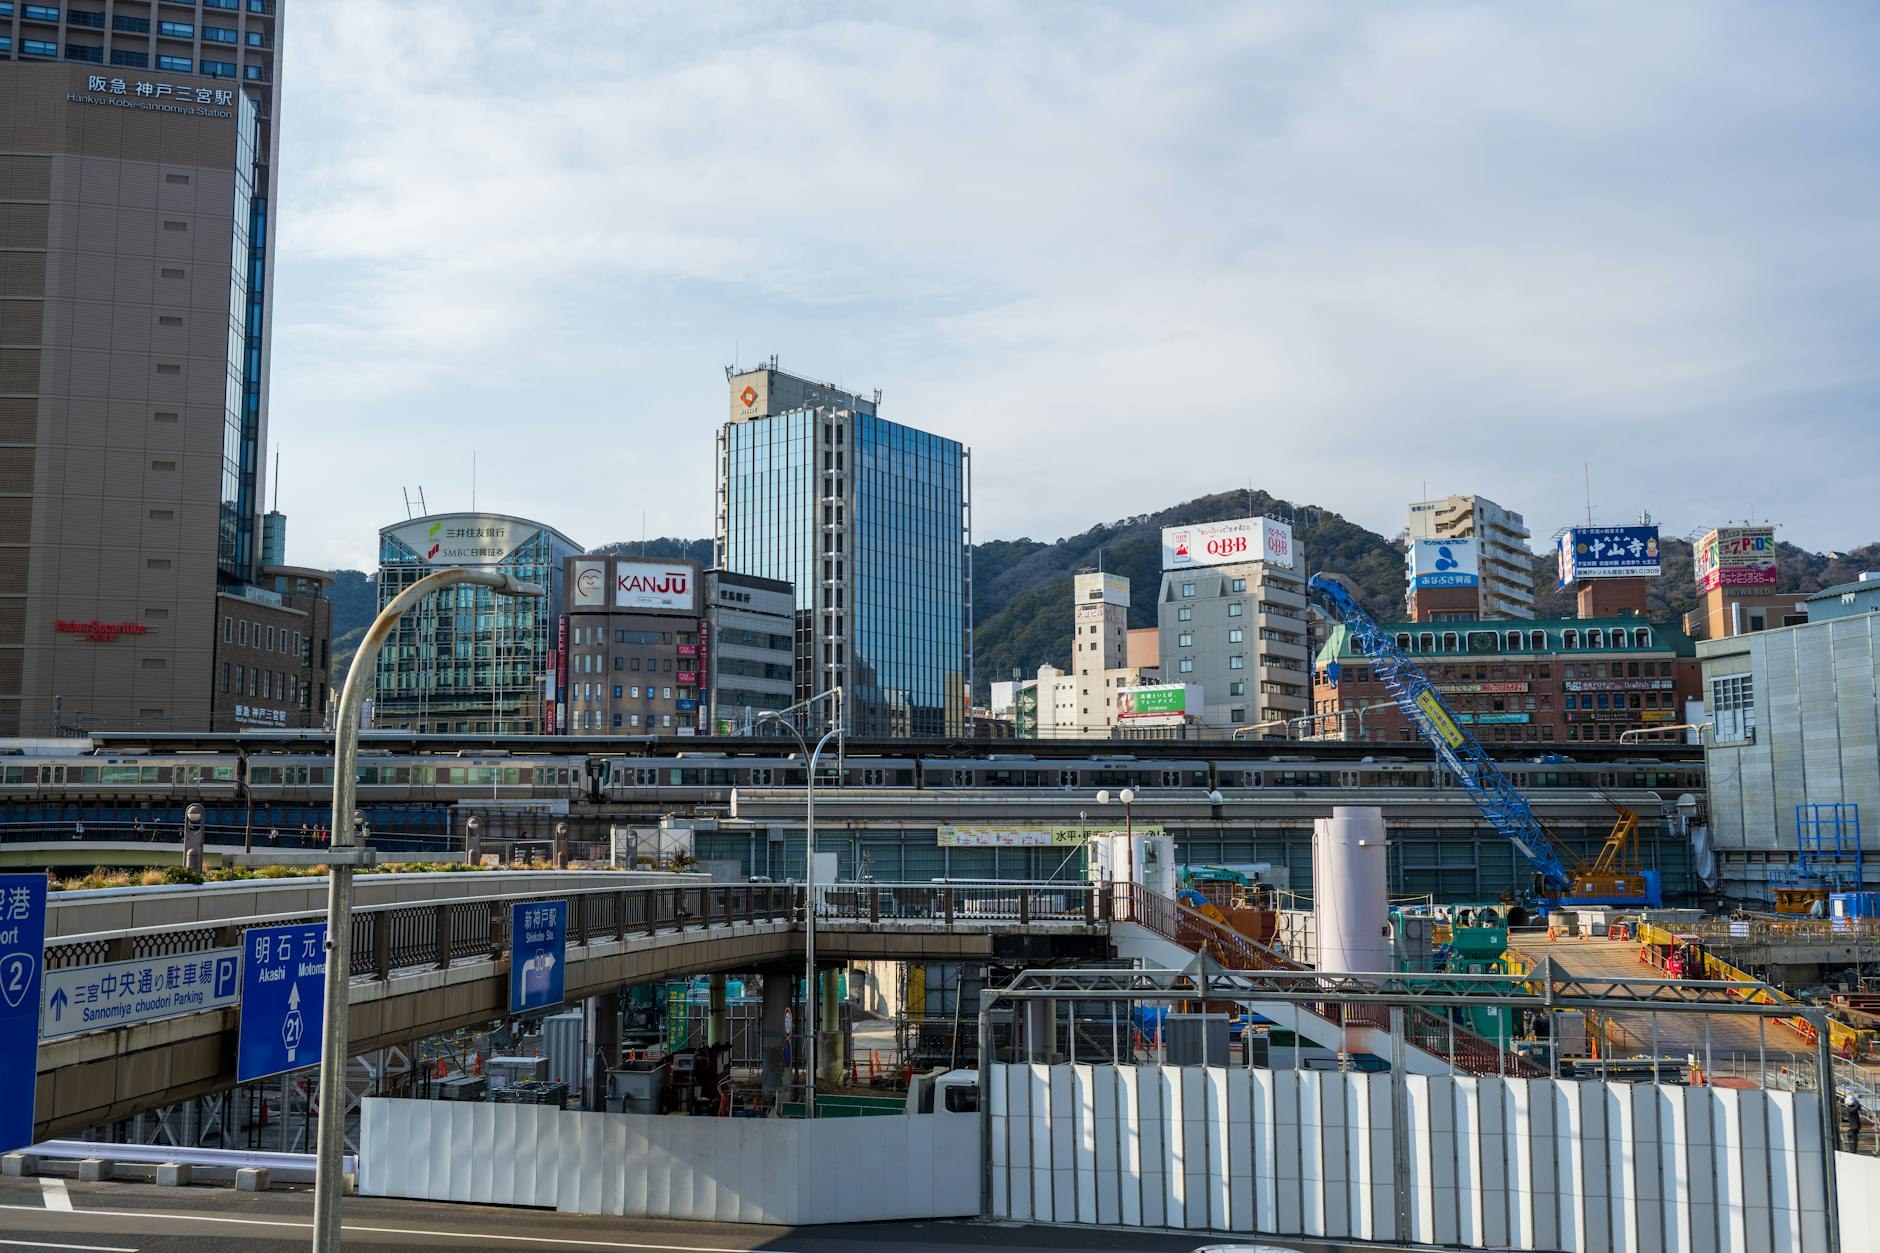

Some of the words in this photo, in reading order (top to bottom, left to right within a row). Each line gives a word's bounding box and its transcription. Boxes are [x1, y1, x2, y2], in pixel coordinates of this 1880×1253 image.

[88, 75, 127, 95] 阪急
[136, 81, 232, 106] 神戸三宮駅
[67, 92, 106, 105] Hankyu
[109, 98, 195, 116] Kobe-sannomiya
[197, 107, 232, 118] Station
[446, 527, 505, 538] 三井住友銀行
[1589, 537, 1644, 559] 中山寺
[235, 704, 250, 717] 阪急
[0, 886, 31, 921] 港
[525, 907, 557, 930] 新神戸駅
[0, 926, 19, 945] ort
[9, 960, 23, 992] 2
[258, 965, 286, 983] Akashi
[298, 961, 327, 977] Motoma
[83, 1001, 132, 1022] Sannomiya
[135, 996, 171, 1013] chuodori
[174, 990, 204, 1006] Parking
[286, 1018, 301, 1042] 21
